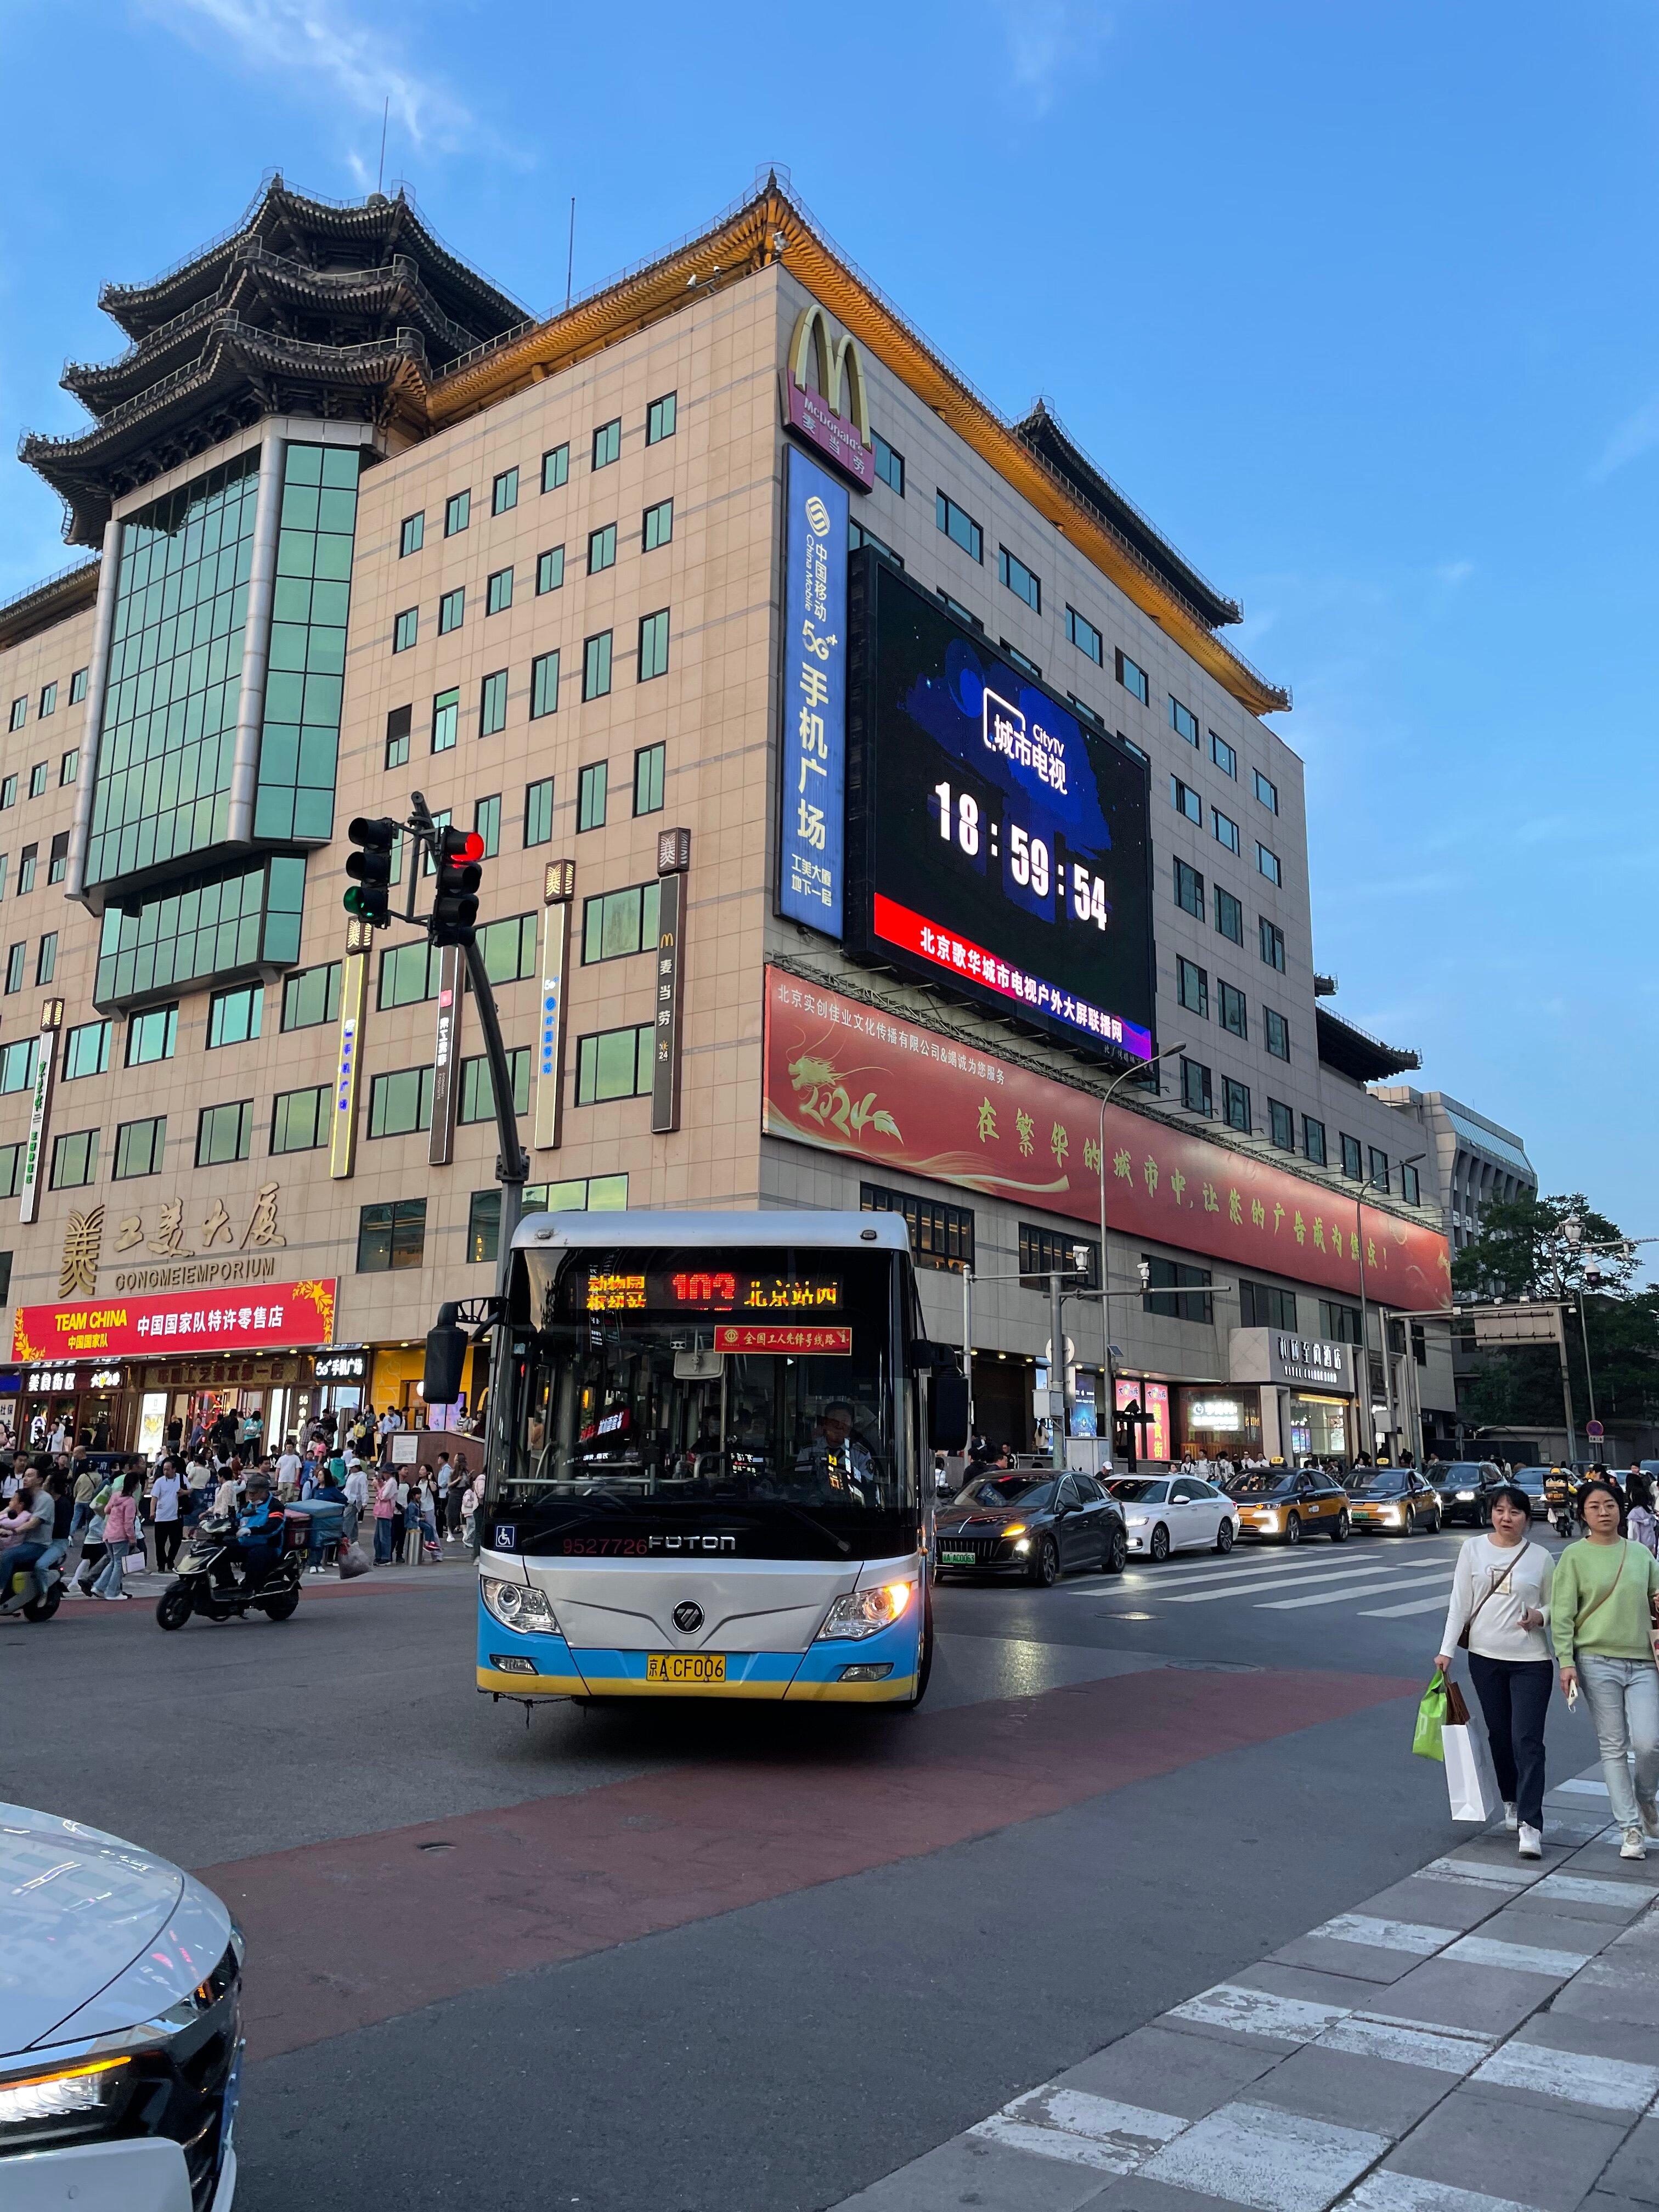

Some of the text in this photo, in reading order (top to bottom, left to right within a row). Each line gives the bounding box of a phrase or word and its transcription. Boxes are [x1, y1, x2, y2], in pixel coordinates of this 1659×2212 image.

[802, 412, 865, 475] 麦当劳
[804, 397, 864, 456] McDonald's
[804, 534, 815, 612] China Mobile
[814, 543, 827, 623] 中国移动
[798, 661, 830, 850] 手机广场
[993, 713, 1068, 795] 城市电视
[1032, 723, 1065, 758] CityTV
[791, 853, 832, 888] 工美大厦
[934, 781, 1108, 931] 18:59:54
[791, 873, 832, 907] 地下一层
[658, 959, 673, 1027] 麦当劳
[919, 926, 1123, 1043] 北京歌华城市电视户外大屏联播网
[658, 1051, 668, 1059] 24
[799, 1086, 879, 1142] 2024
[114, 1182, 286, 1258] 工美大厦
[55, 1308, 128, 1332] TEAM CHINA
[67, 1333, 109, 1350] 中国国家队
[137, 1305, 284, 1338] 中国国家队特许零售店
[743, 1331, 836, 1347] 全国工人先锋号线路
[29, 1372, 76, 1392] 美食街区
[1153, 1402, 1163, 1459] 美食街
[563, 1538, 647, 1554] 9527726
[648, 1535, 736, 1550] FOTON
